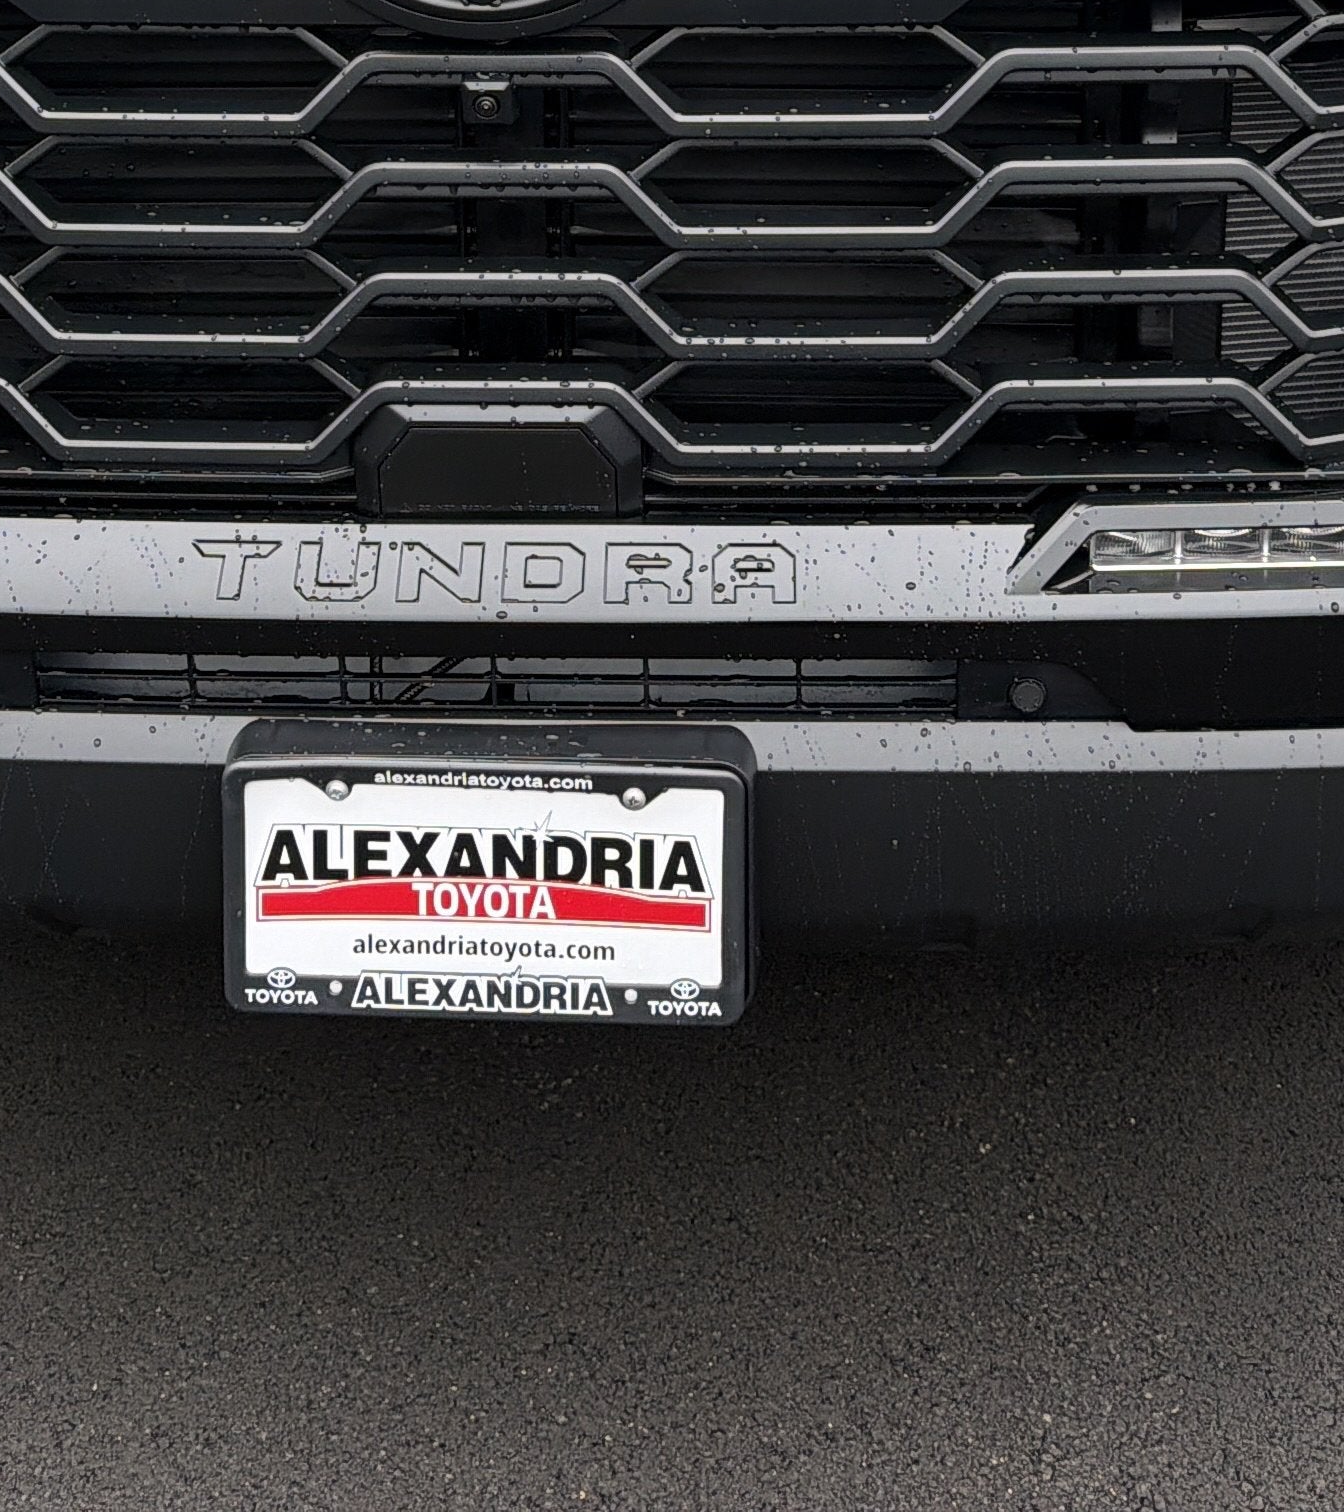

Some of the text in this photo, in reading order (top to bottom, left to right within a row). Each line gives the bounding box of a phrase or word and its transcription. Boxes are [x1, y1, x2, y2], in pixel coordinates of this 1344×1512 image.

[191, 539, 797, 604] TUNDRA
[373, 769, 594, 792] alexandriatoyota.com
[256, 824, 712, 897] ALEXANDRIA
[411, 881, 557, 920] TOYOTA
[352, 933, 616, 963] alexandriatoyota.com
[244, 987, 319, 1007] TOYOTA
[351, 969, 614, 1017] ALEXANDRIA
[647, 998, 723, 1019] TOYOTA
